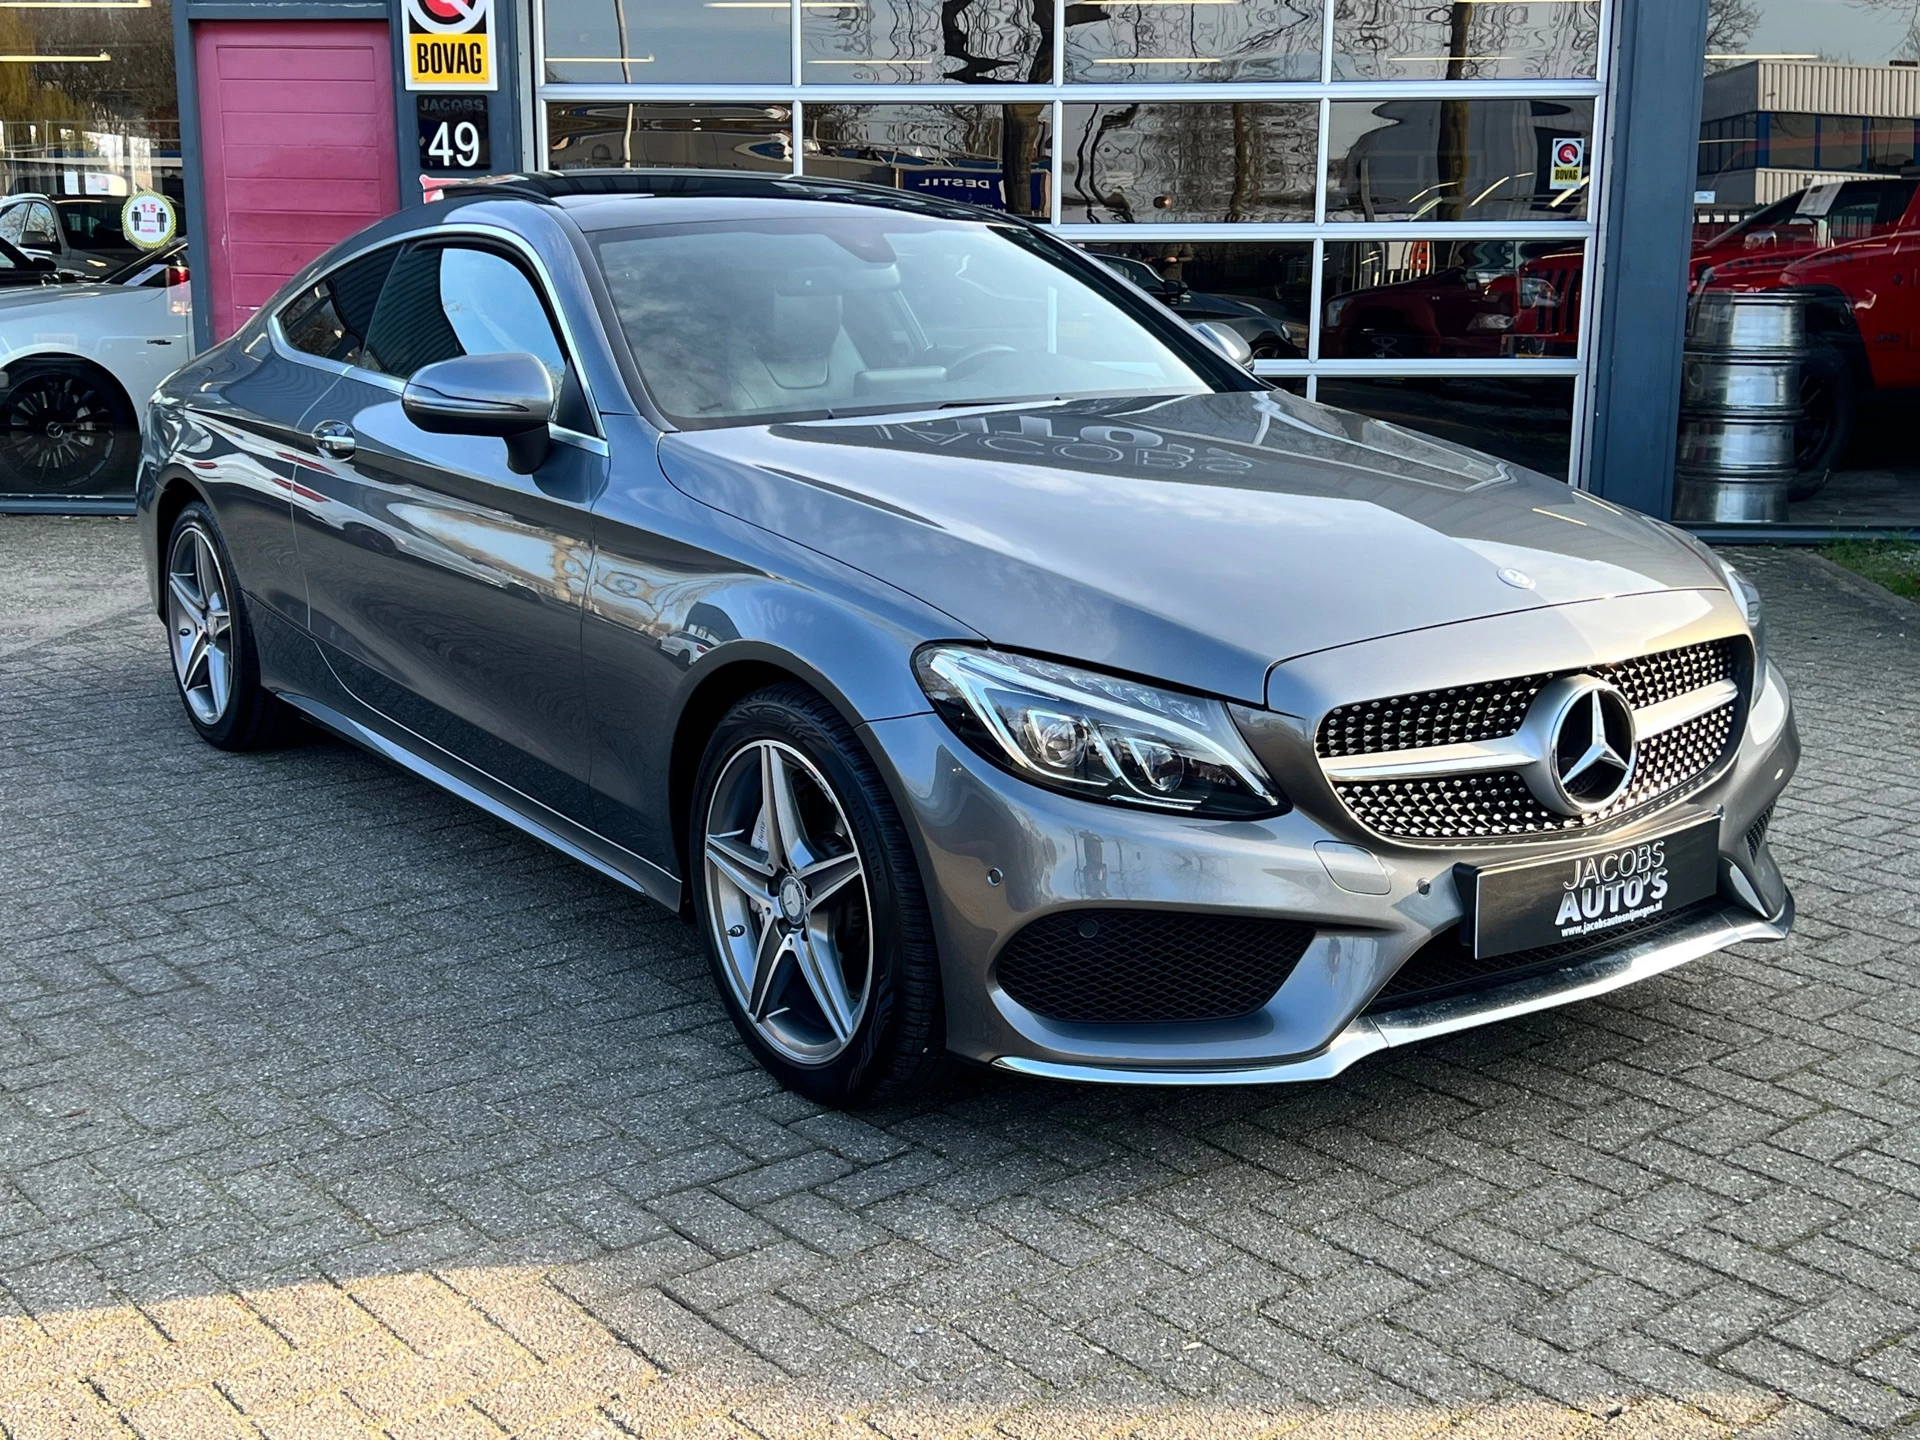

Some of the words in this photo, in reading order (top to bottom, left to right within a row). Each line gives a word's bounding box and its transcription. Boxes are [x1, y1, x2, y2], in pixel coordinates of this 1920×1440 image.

[416, 42, 482, 74] BOVAG
[420, 99, 484, 112] JACOBS
[428, 121, 480, 167] 49
[1555, 169, 1578, 180] BOVAG
[142, 203, 156, 213] 1.5
[1562, 839, 1665, 890] JACOBS
[1554, 866, 1669, 926] AUTO'S
[1561, 900, 1663, 938] www.jacobsautosnijmegen.nl
